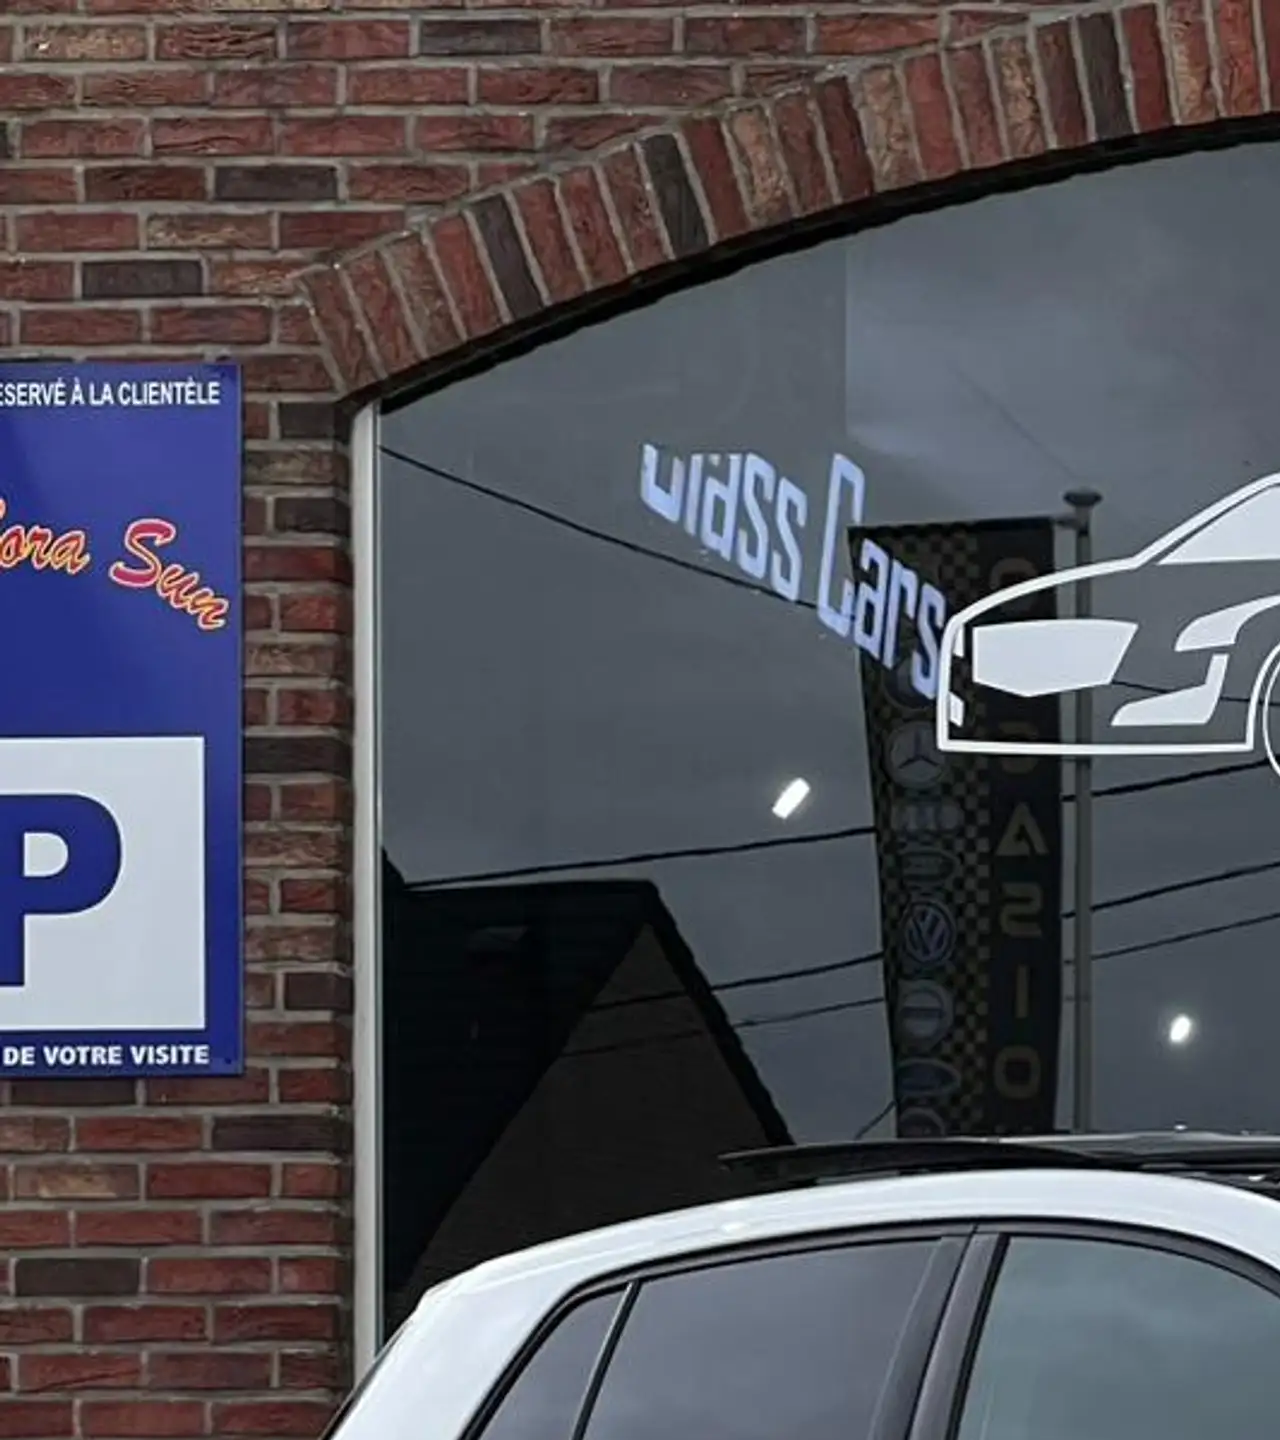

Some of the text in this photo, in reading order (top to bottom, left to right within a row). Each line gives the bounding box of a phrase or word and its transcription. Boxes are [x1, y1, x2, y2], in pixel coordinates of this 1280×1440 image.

[70, 377, 85, 405] À
[90, 382, 114, 405] LA
[117, 377, 220, 406] CLIENTÈLE
[0, 498, 229, 630] ora Sun
[817, 453, 947, 700] Cars
[0, 794, 122, 986] P
[4, 1045, 209, 1065] DE VOTRE VISITE
